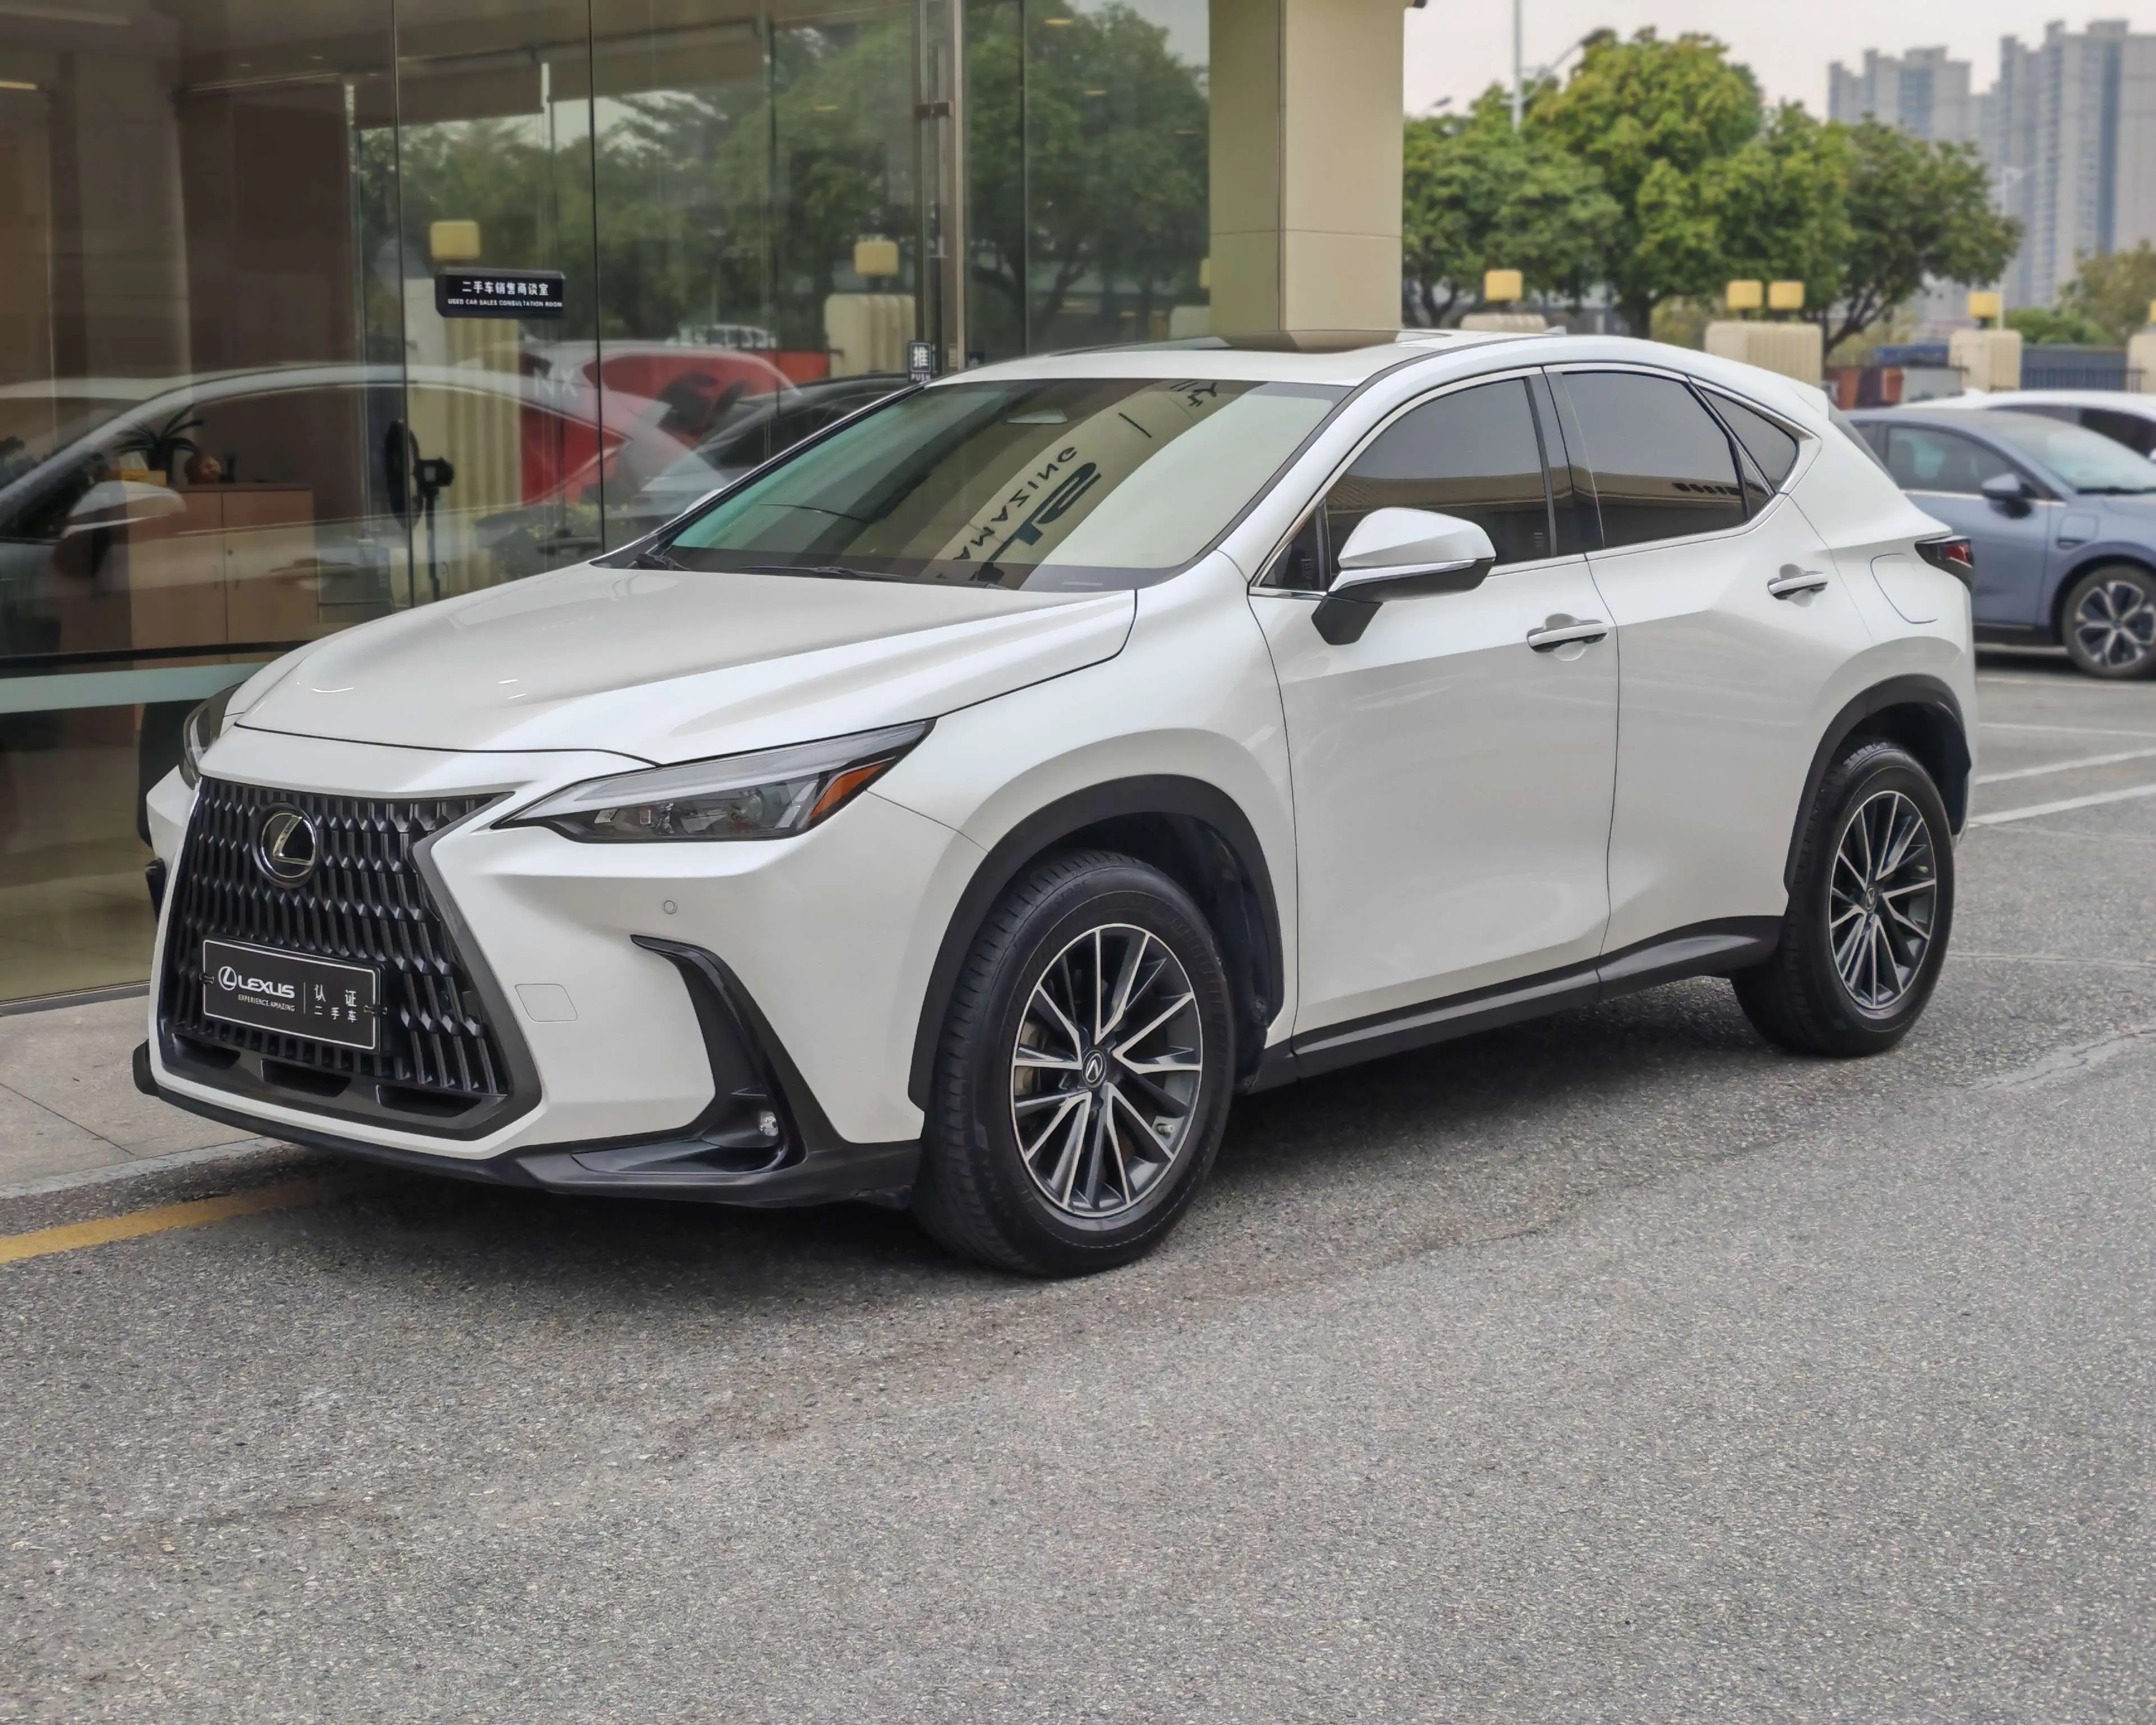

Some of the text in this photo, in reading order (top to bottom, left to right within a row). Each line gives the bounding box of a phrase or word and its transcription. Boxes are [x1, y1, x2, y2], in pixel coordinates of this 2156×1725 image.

[913, 346, 929, 368] 推
[911, 373, 930, 382] PUSH
[238, 975, 295, 998] LEXUS
